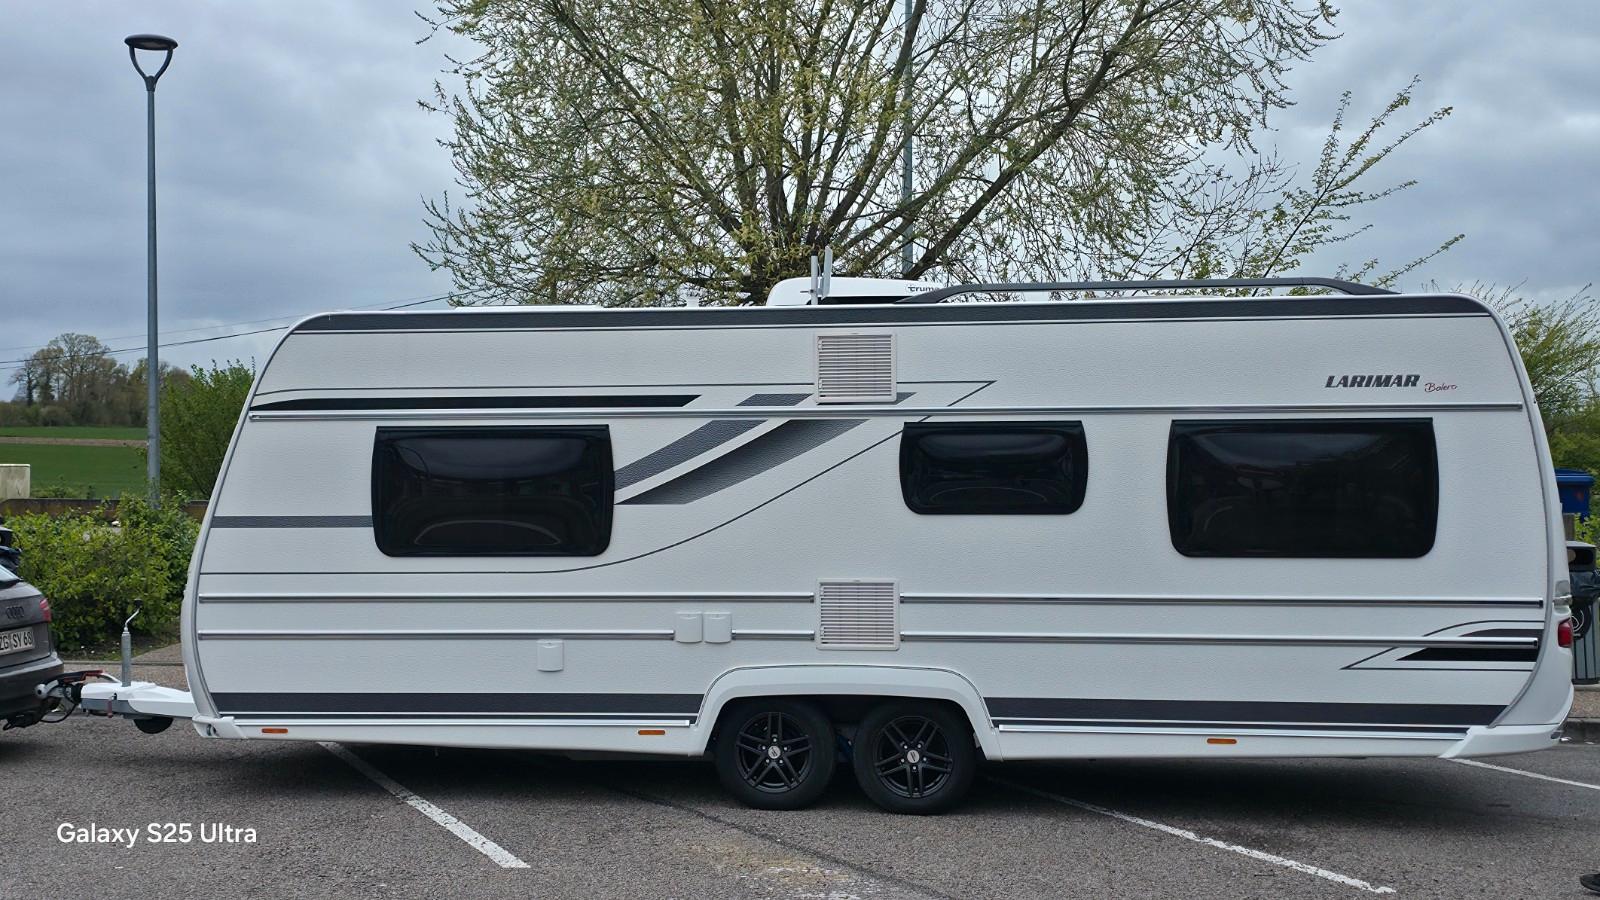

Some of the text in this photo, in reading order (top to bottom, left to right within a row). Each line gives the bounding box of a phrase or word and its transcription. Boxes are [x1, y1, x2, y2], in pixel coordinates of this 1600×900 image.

[1325, 375, 1458, 393] LARIMAR Bolero
[12, 633, 22, 648] SY
